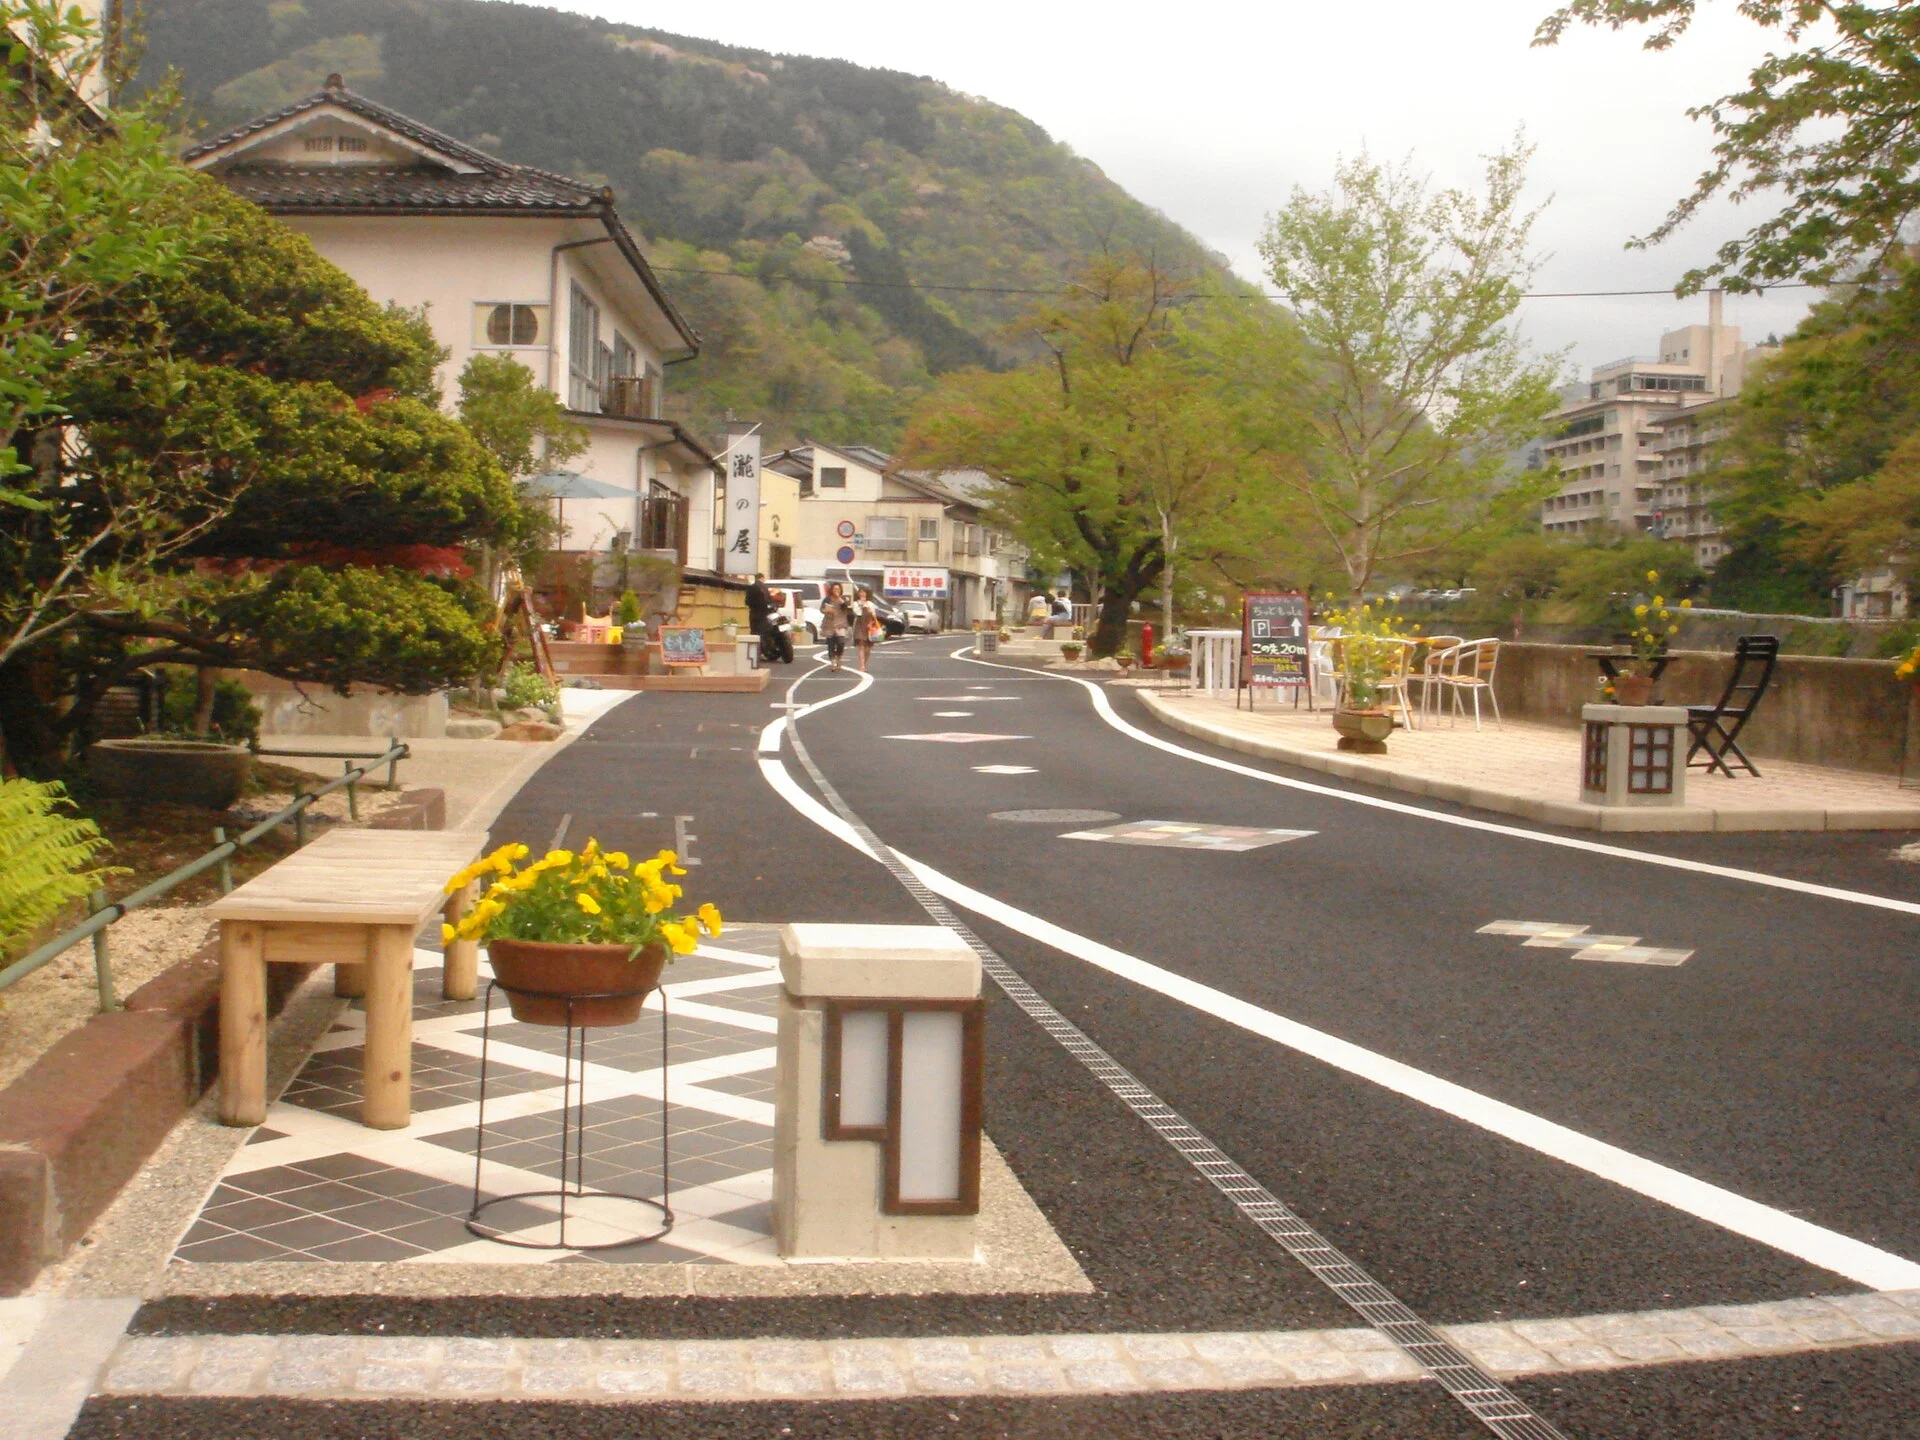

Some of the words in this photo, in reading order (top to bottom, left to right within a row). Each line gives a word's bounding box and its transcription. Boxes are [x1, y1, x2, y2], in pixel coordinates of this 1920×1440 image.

[729, 454, 754, 554] 瀧の屋
[888, 576, 944, 588] 専用駐車場
[1258, 622, 1266, 635] P
